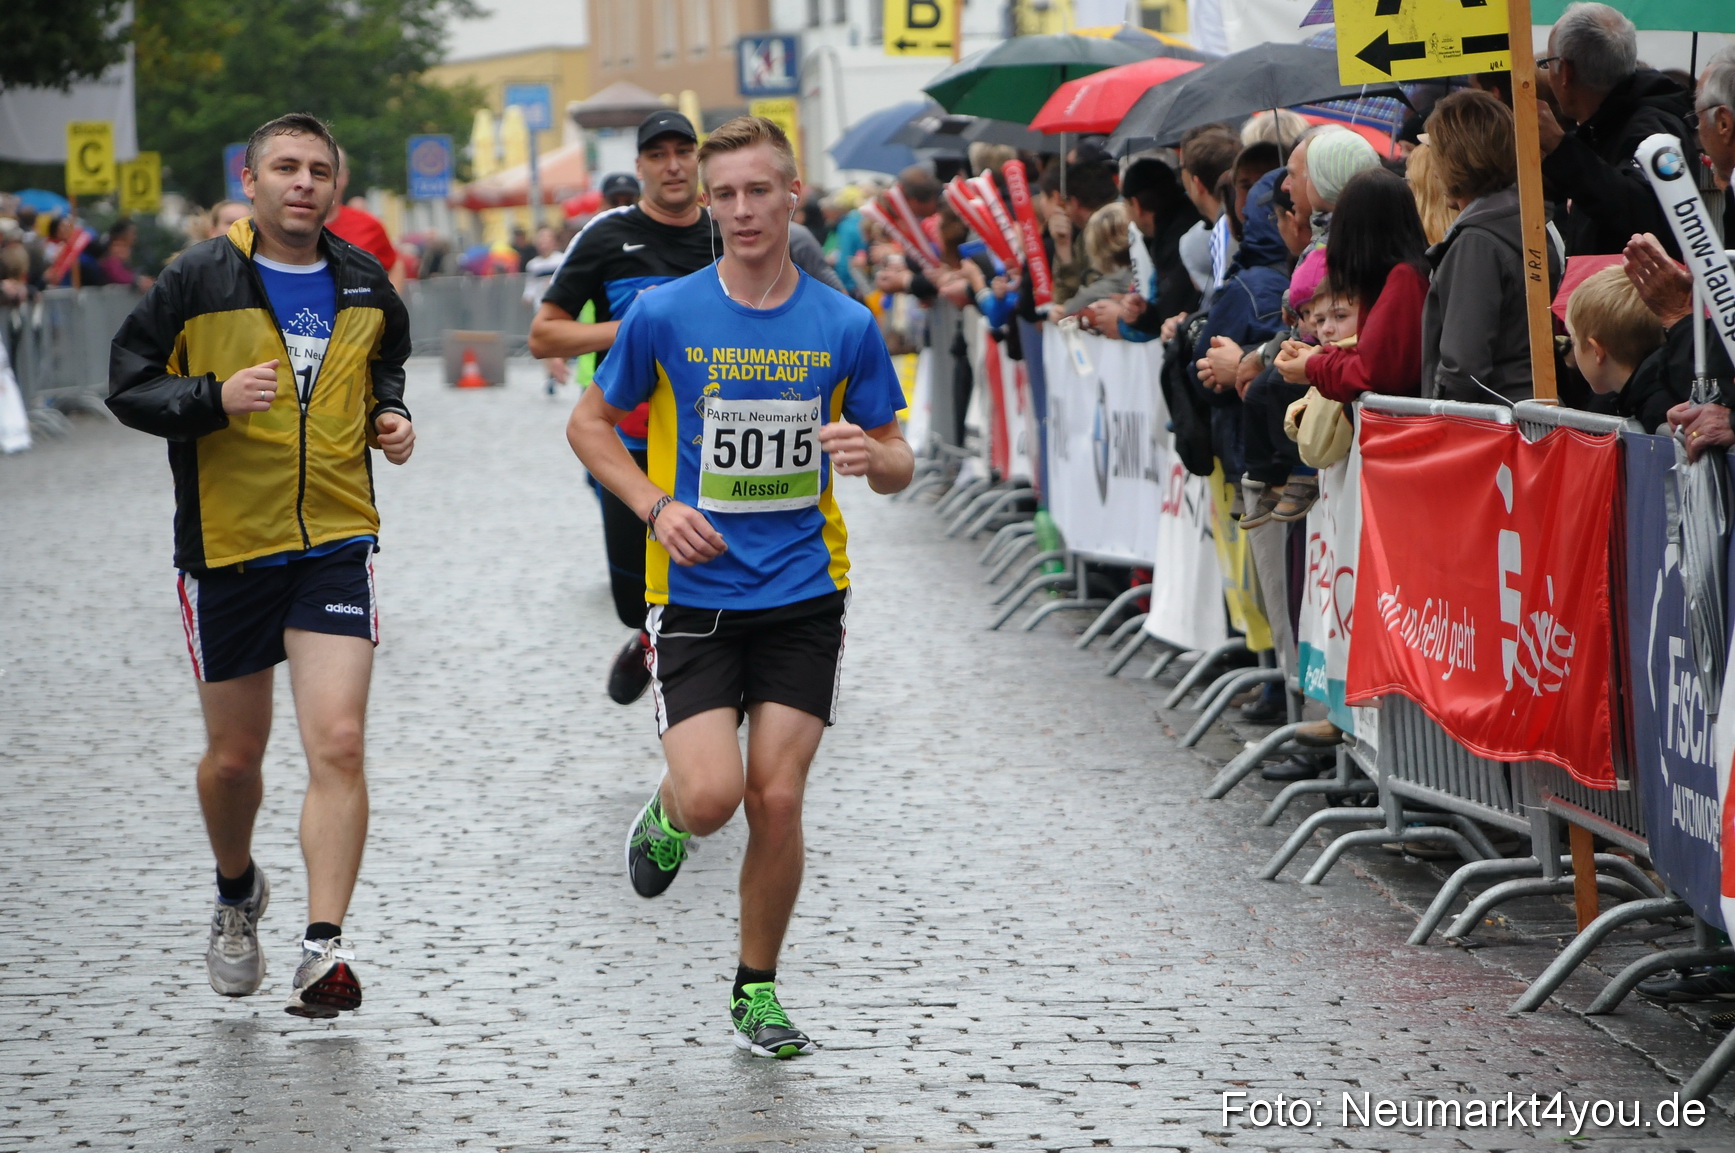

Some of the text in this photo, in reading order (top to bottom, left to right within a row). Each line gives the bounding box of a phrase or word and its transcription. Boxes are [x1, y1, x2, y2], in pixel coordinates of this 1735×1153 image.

[79, 140, 104, 176] C
[685, 346, 831, 367] 10. NEUMARKTER
[708, 364, 808, 382] STADTLAUF
[706, 408, 807, 423] PARTL Neumarkt
[713, 428, 813, 469] 5015
[731, 480, 789, 497] Alessio
[325, 603, 364, 615] adidas
[1441, 606, 1476, 681] geht
